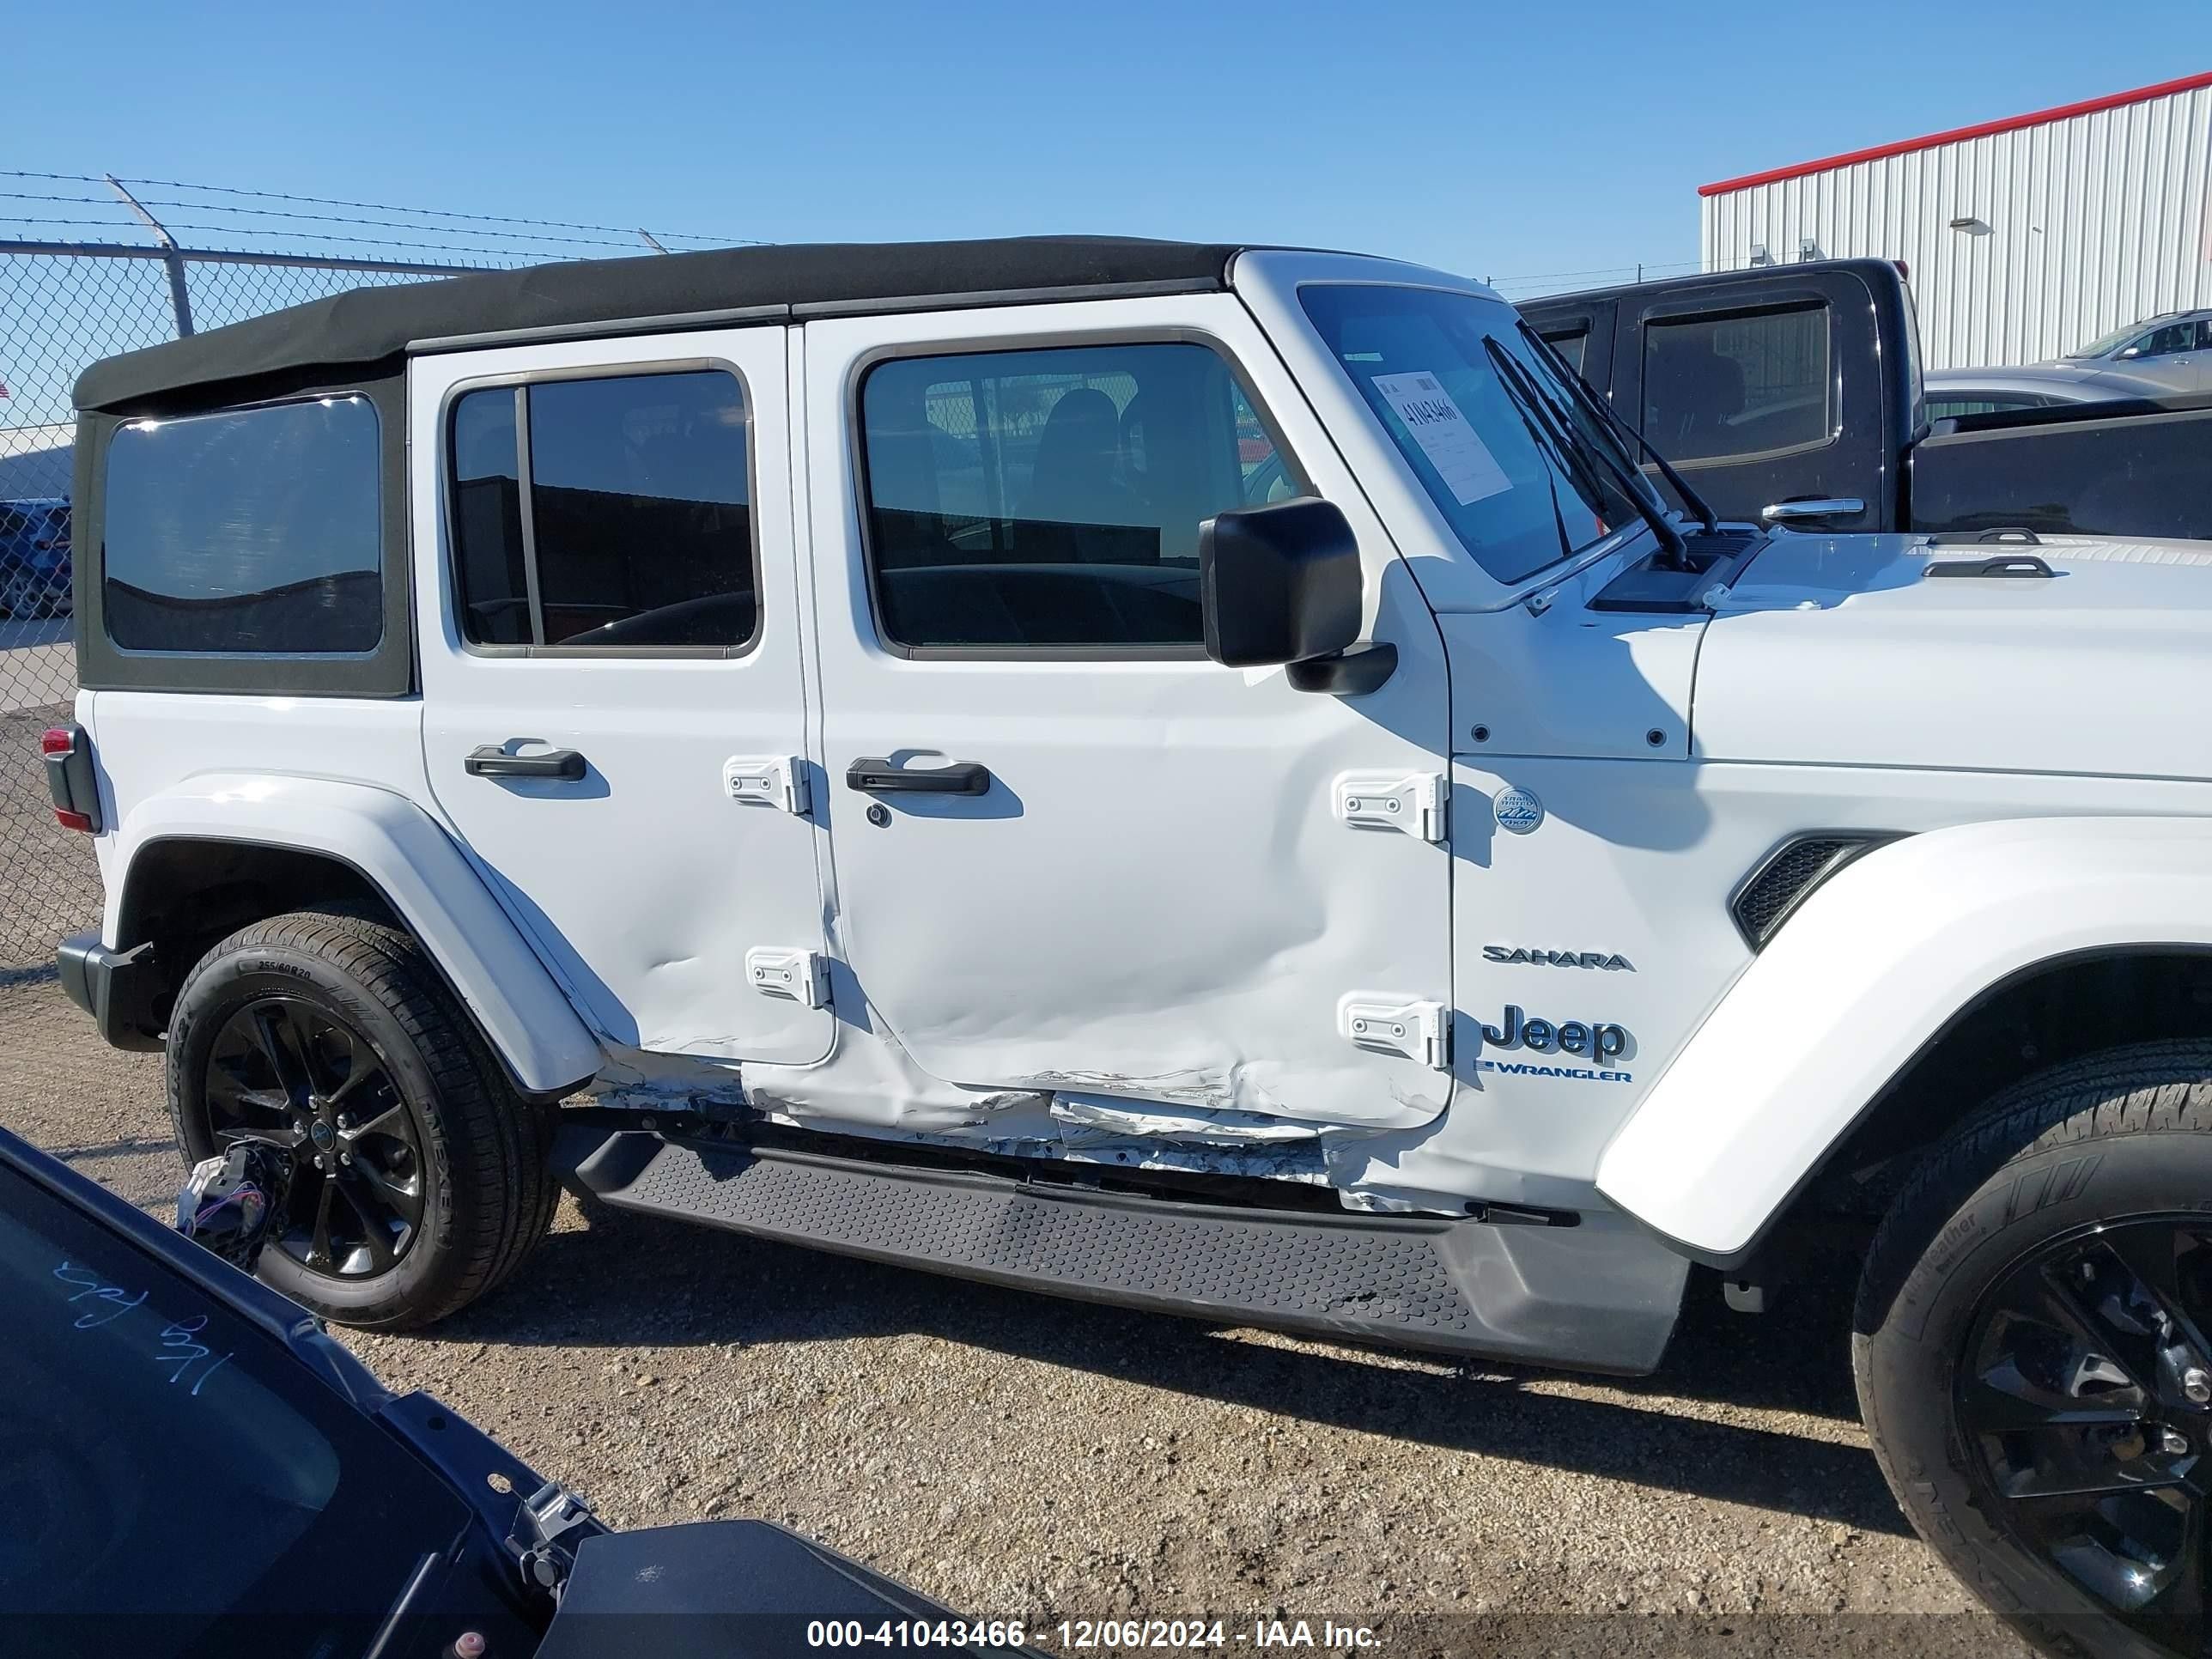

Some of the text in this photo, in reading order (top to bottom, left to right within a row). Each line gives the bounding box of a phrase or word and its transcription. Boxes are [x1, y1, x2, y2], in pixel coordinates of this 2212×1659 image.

[1402, 398, 1457, 427] 41043466
[1482, 945, 1632, 971] SAHARA
[1481, 1005, 1630, 1066] Jeep
[1496, 1061, 1632, 1083] WRANGLER
[423, 1114, 453, 1231] NEXEN
